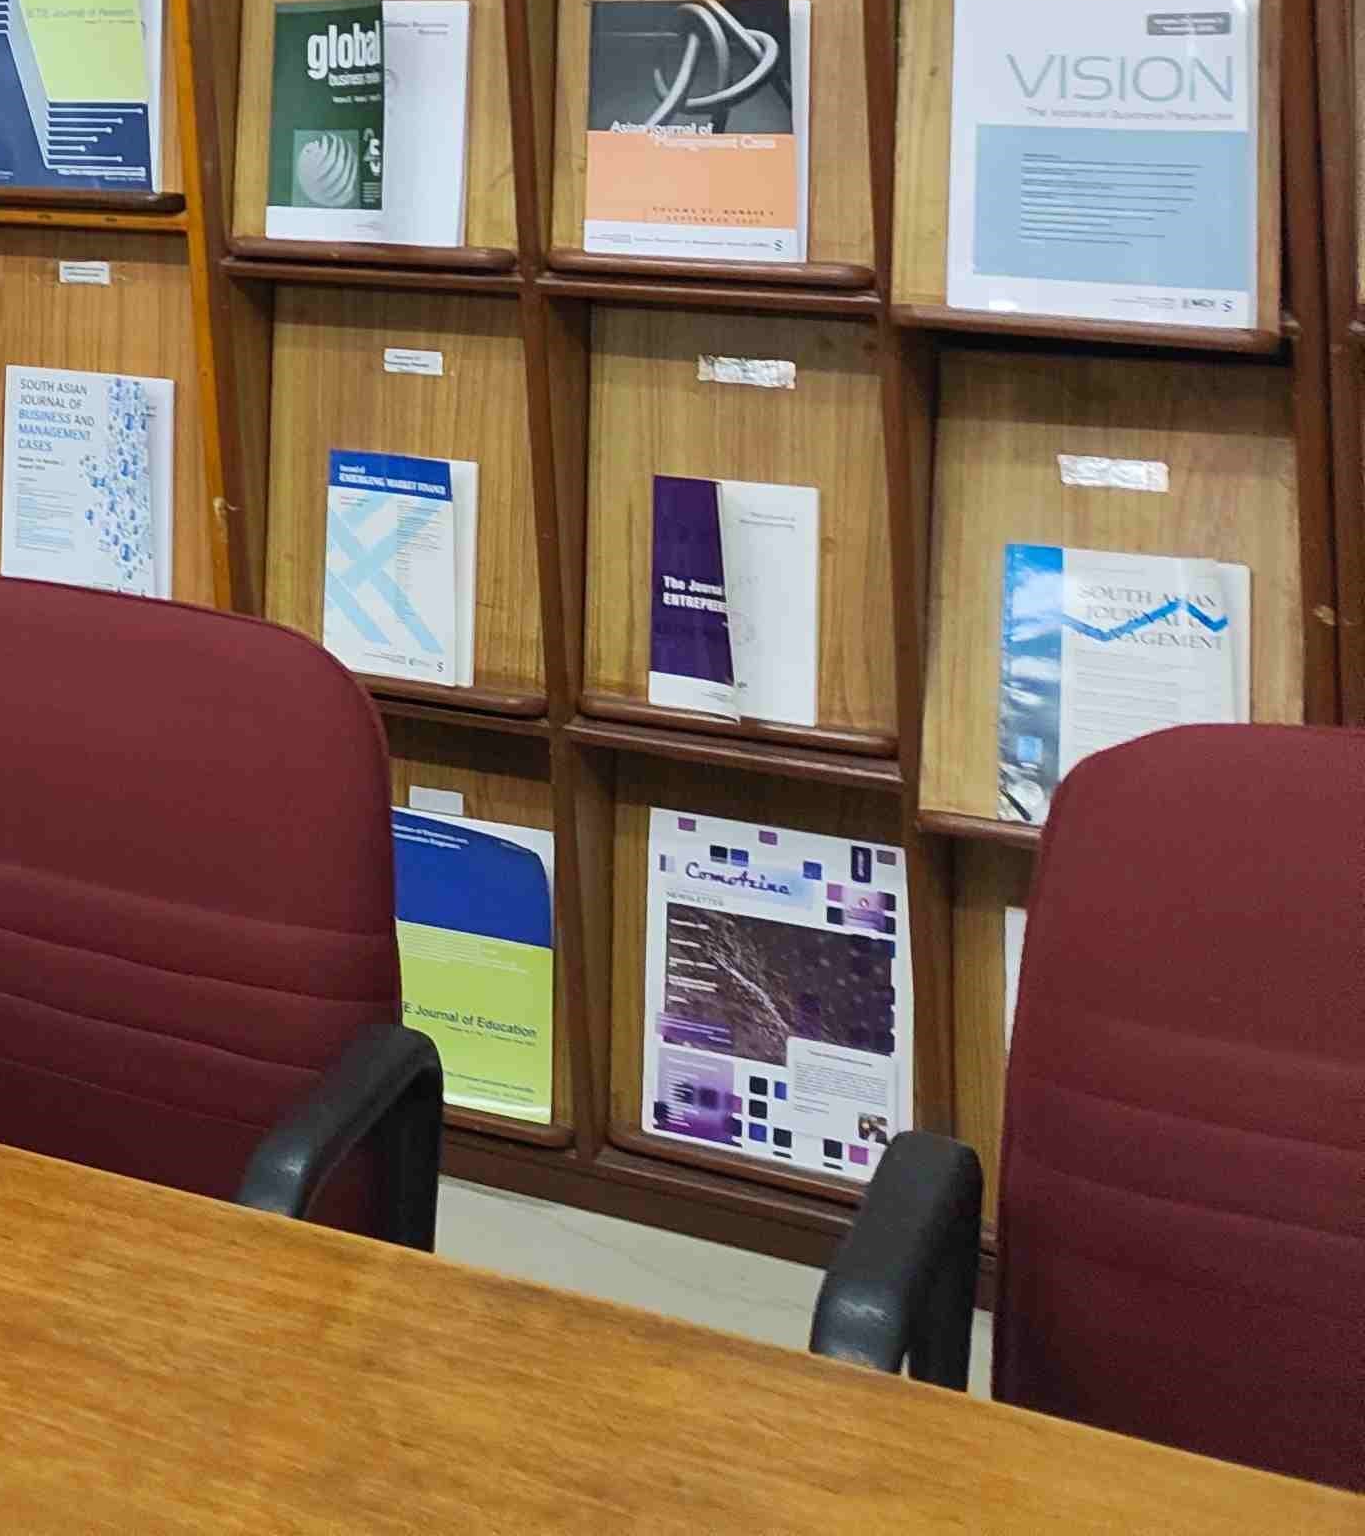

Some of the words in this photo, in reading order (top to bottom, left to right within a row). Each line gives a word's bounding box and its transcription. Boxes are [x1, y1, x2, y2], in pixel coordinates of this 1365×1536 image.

[1005, 53, 1234, 103] VISION
[20, 379, 54, 393] SOUTH
[57, 381, 88, 395] ASIAN
[20, 394, 66, 408] JOURNAL
[68, 397, 83, 409] OF
[18, 408, 71, 423] BUSINESS
[74, 413, 95, 426] AND
[18, 422, 92, 441] MANAGEMENT
[17, 438, 53, 452] CASES
[663, 575, 686, 591] The
[1079, 582, 1152, 605] SOUTH
[415, 1005, 459, 1024] Journal
[462, 1013, 475, 1026] of
[477, 1016, 537, 1038] Education
